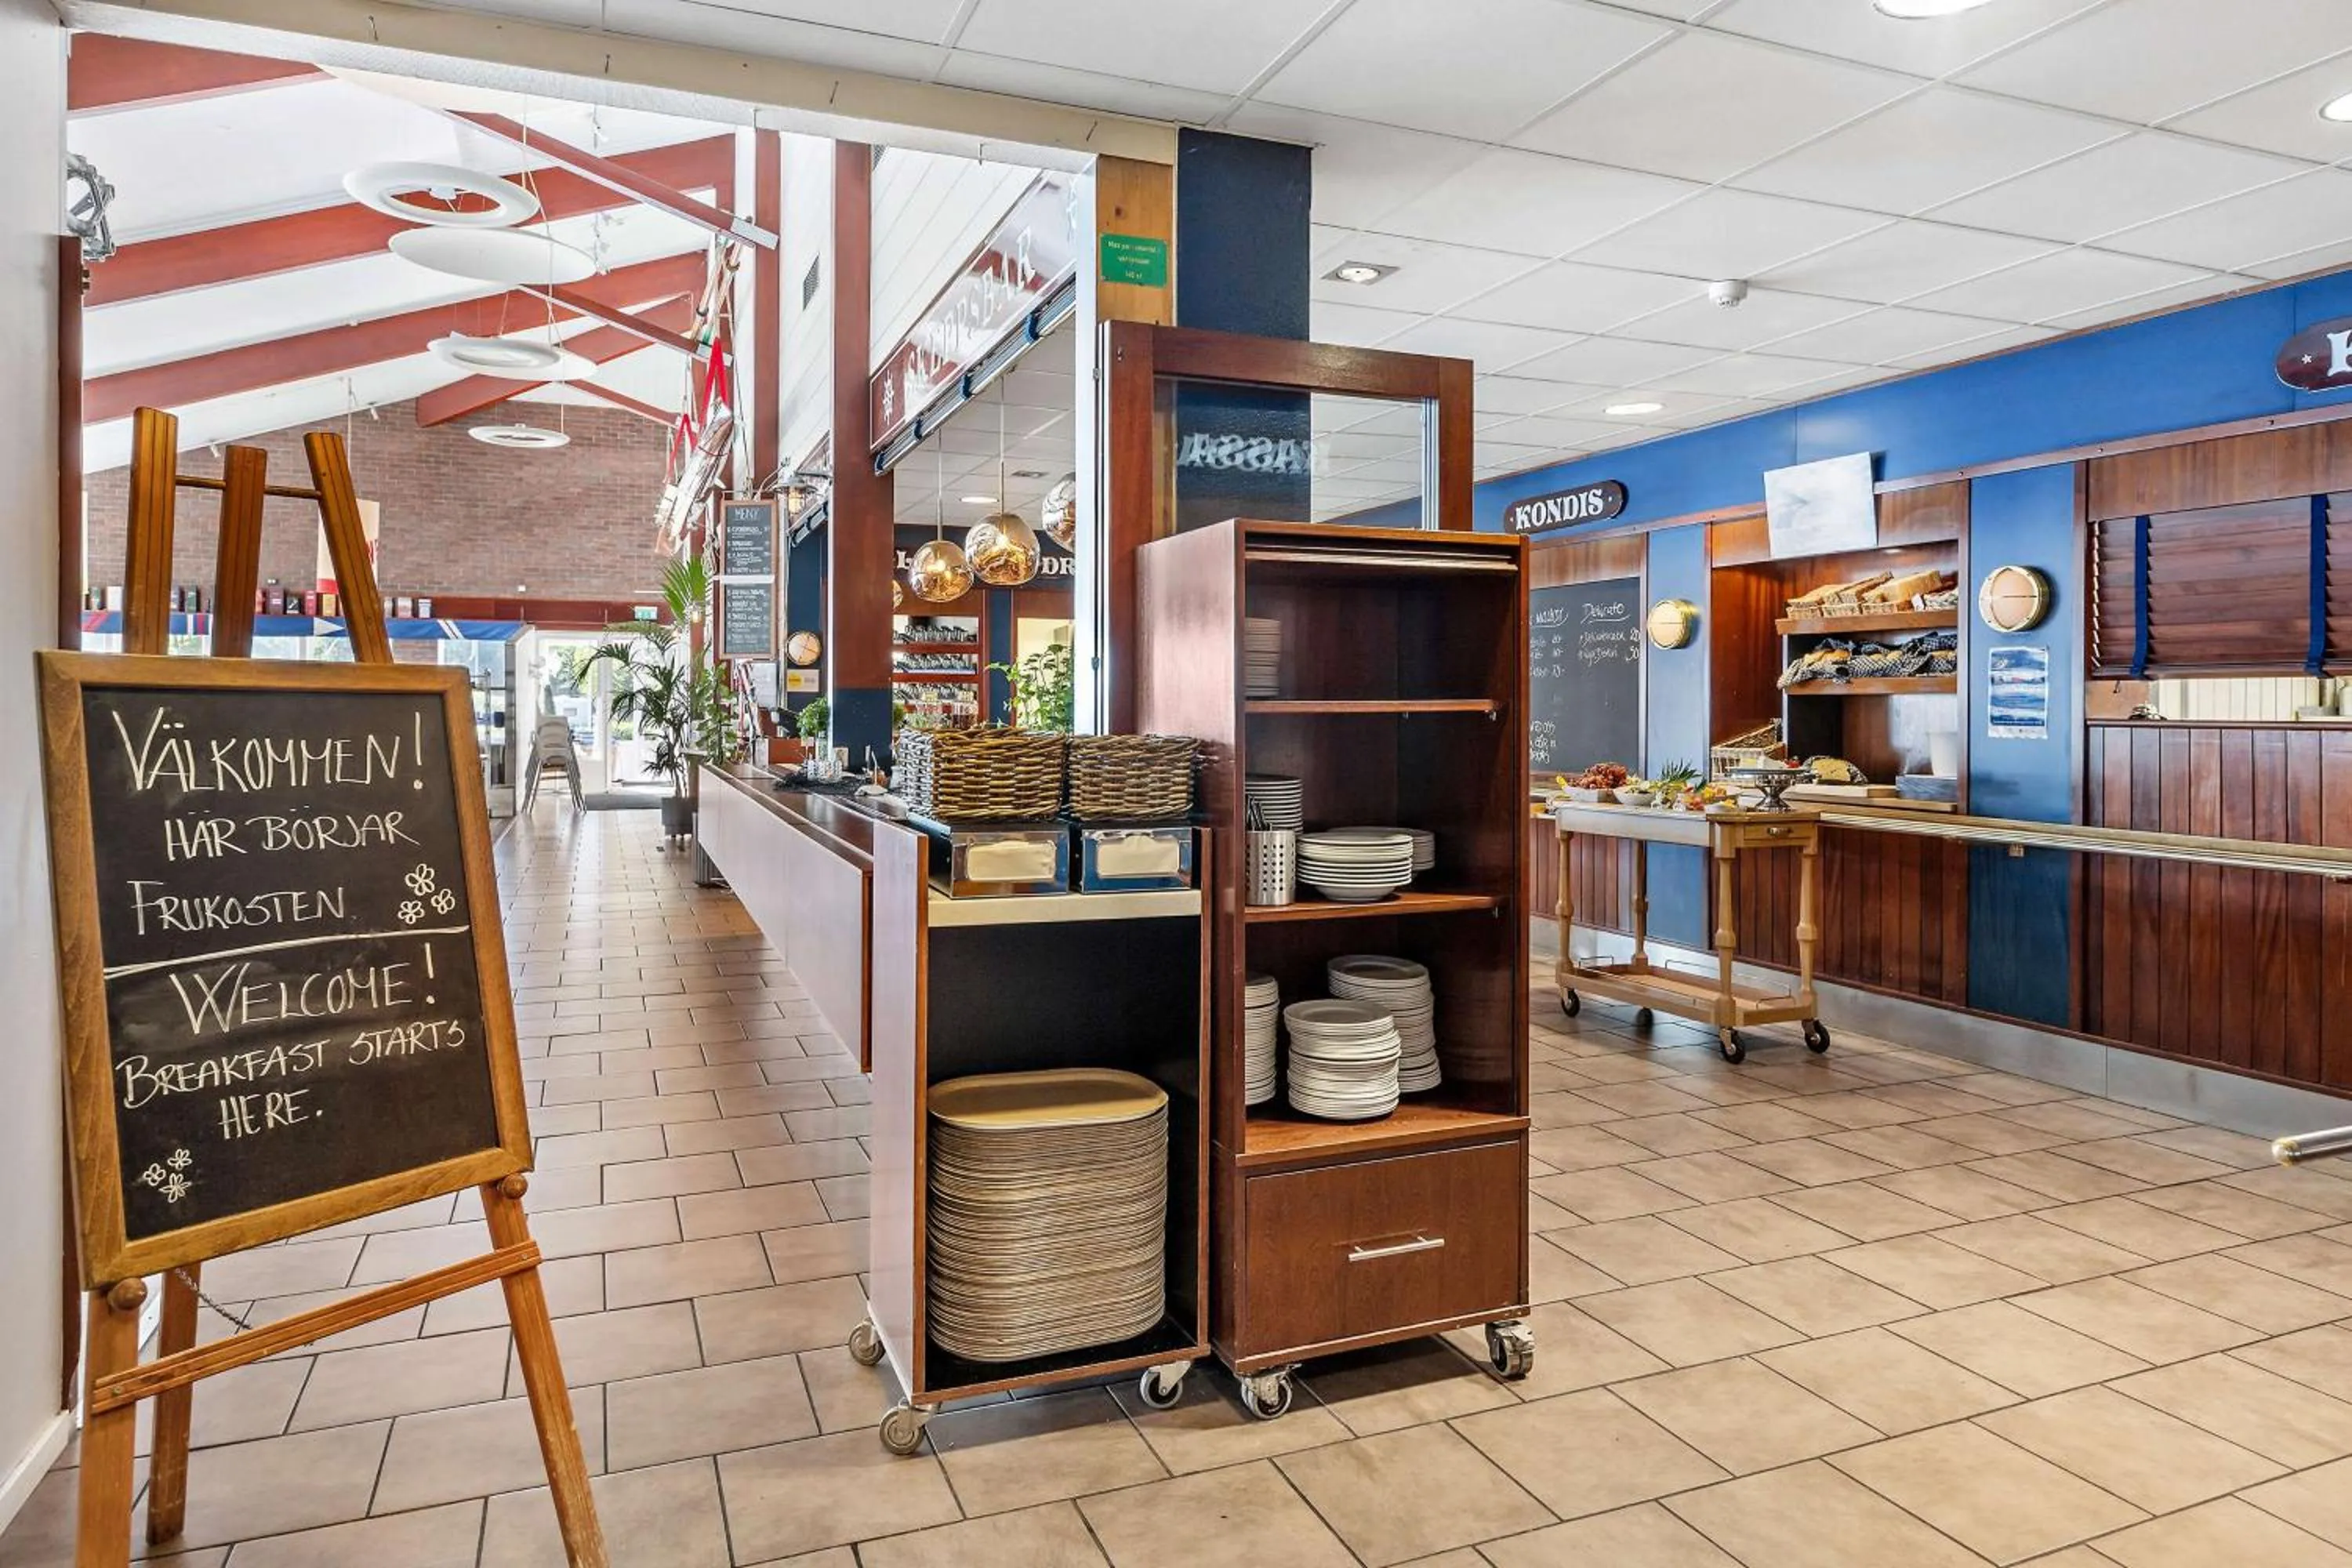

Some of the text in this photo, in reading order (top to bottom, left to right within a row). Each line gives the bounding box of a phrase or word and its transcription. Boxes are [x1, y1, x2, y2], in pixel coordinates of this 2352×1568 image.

[1515, 488, 1604, 531] KONDIS
[112, 706, 423, 793] VÄLKOMMEN!
[165, 805, 420, 861] HÄR BÖRJAR
[127, 880, 346, 935] FRUKOSTEN
[170, 942, 436, 1035] WELCOME!
[115, 1020, 465, 1109] BREAKFAST STARTS
[219, 1089, 323, 1139] HERE.
